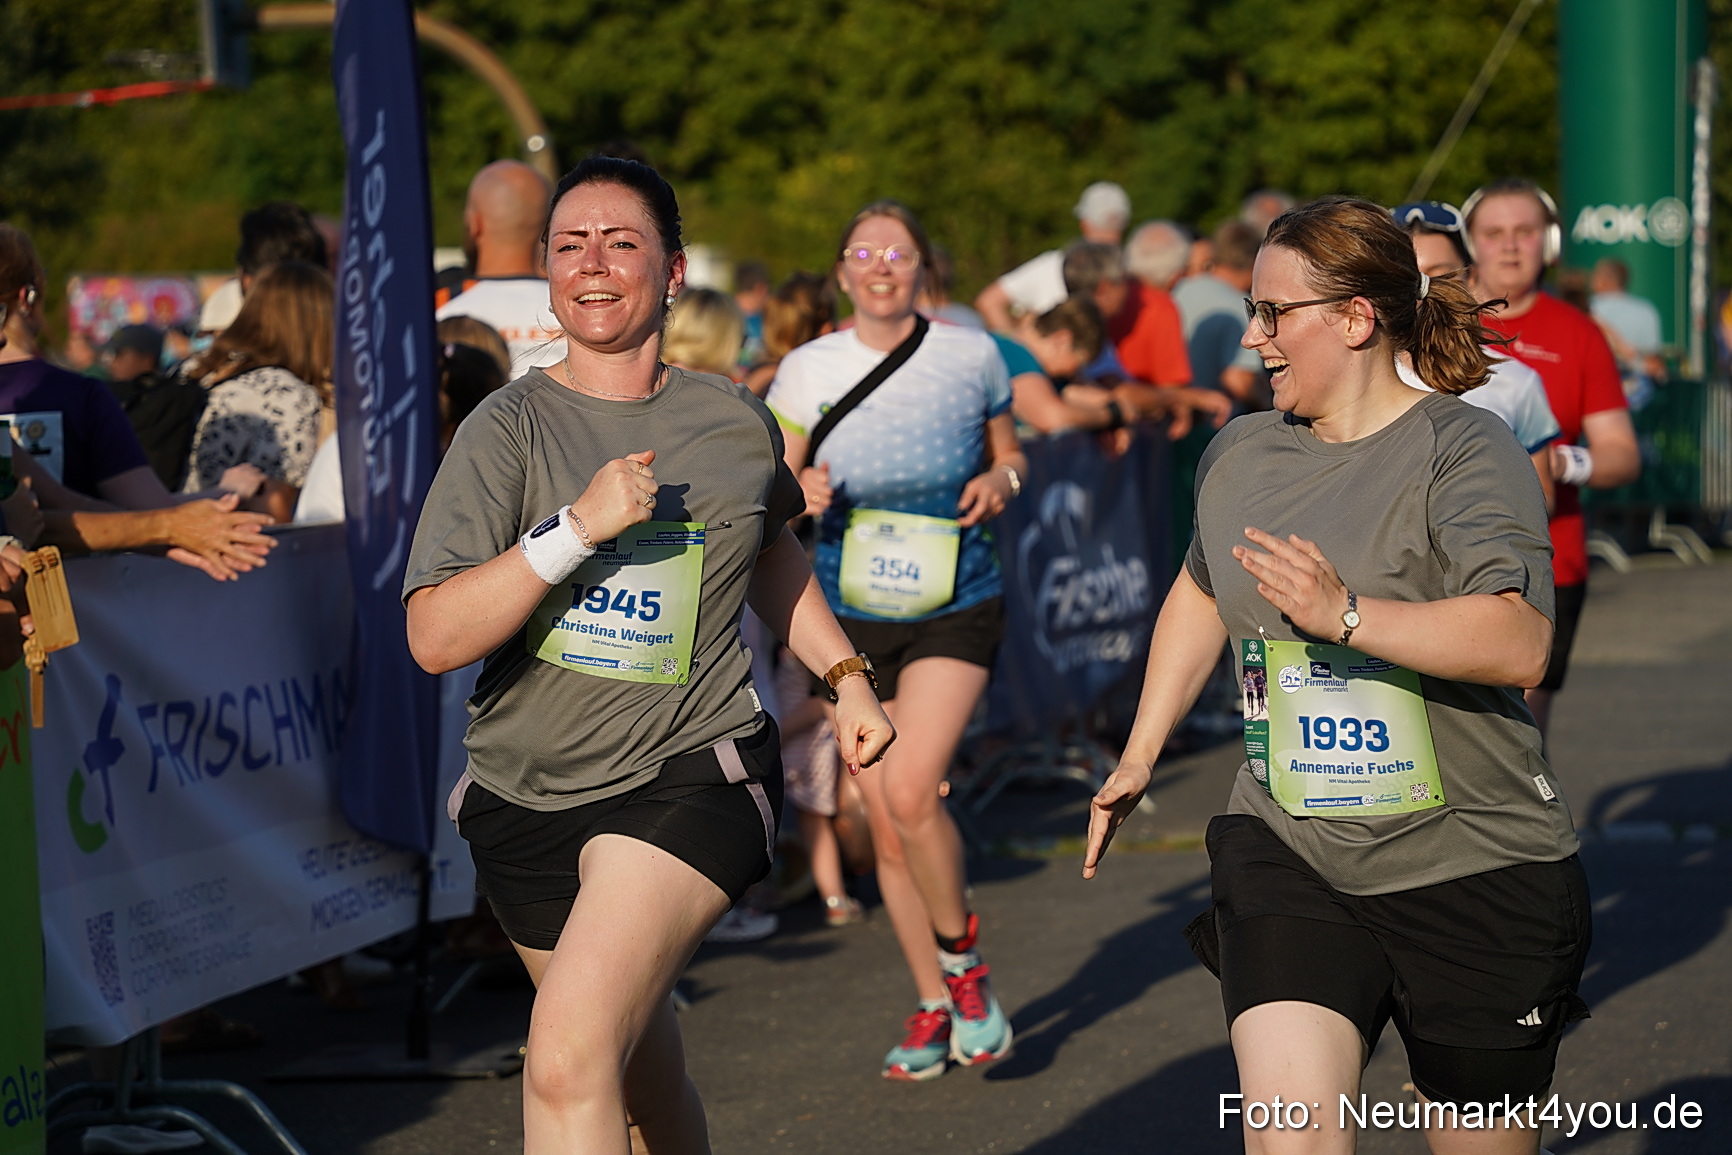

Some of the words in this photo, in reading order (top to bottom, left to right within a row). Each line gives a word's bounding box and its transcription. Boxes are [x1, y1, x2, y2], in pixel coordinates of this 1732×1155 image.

[1571, 203, 1648, 244] AOK
[589, 551, 633, 561] rmenlauf
[871, 556, 920, 580] 354
[570, 583, 661, 622] 1945
[551, 616, 616, 639] Christina
[621, 628, 673, 646] Weigert
[611, 642, 632, 650] Apotheke
[564, 655, 616, 668] firmenlauf.bayern
[1246, 653, 1262, 662] AOK
[1305, 677, 1347, 687] Firmenlauf
[1299, 716, 1390, 752] 1933
[1290, 759, 1364, 775] Annemarie
[1368, 760, 1415, 775] Fuchs
[1307, 799, 1360, 807] firmenlauf.bayern
